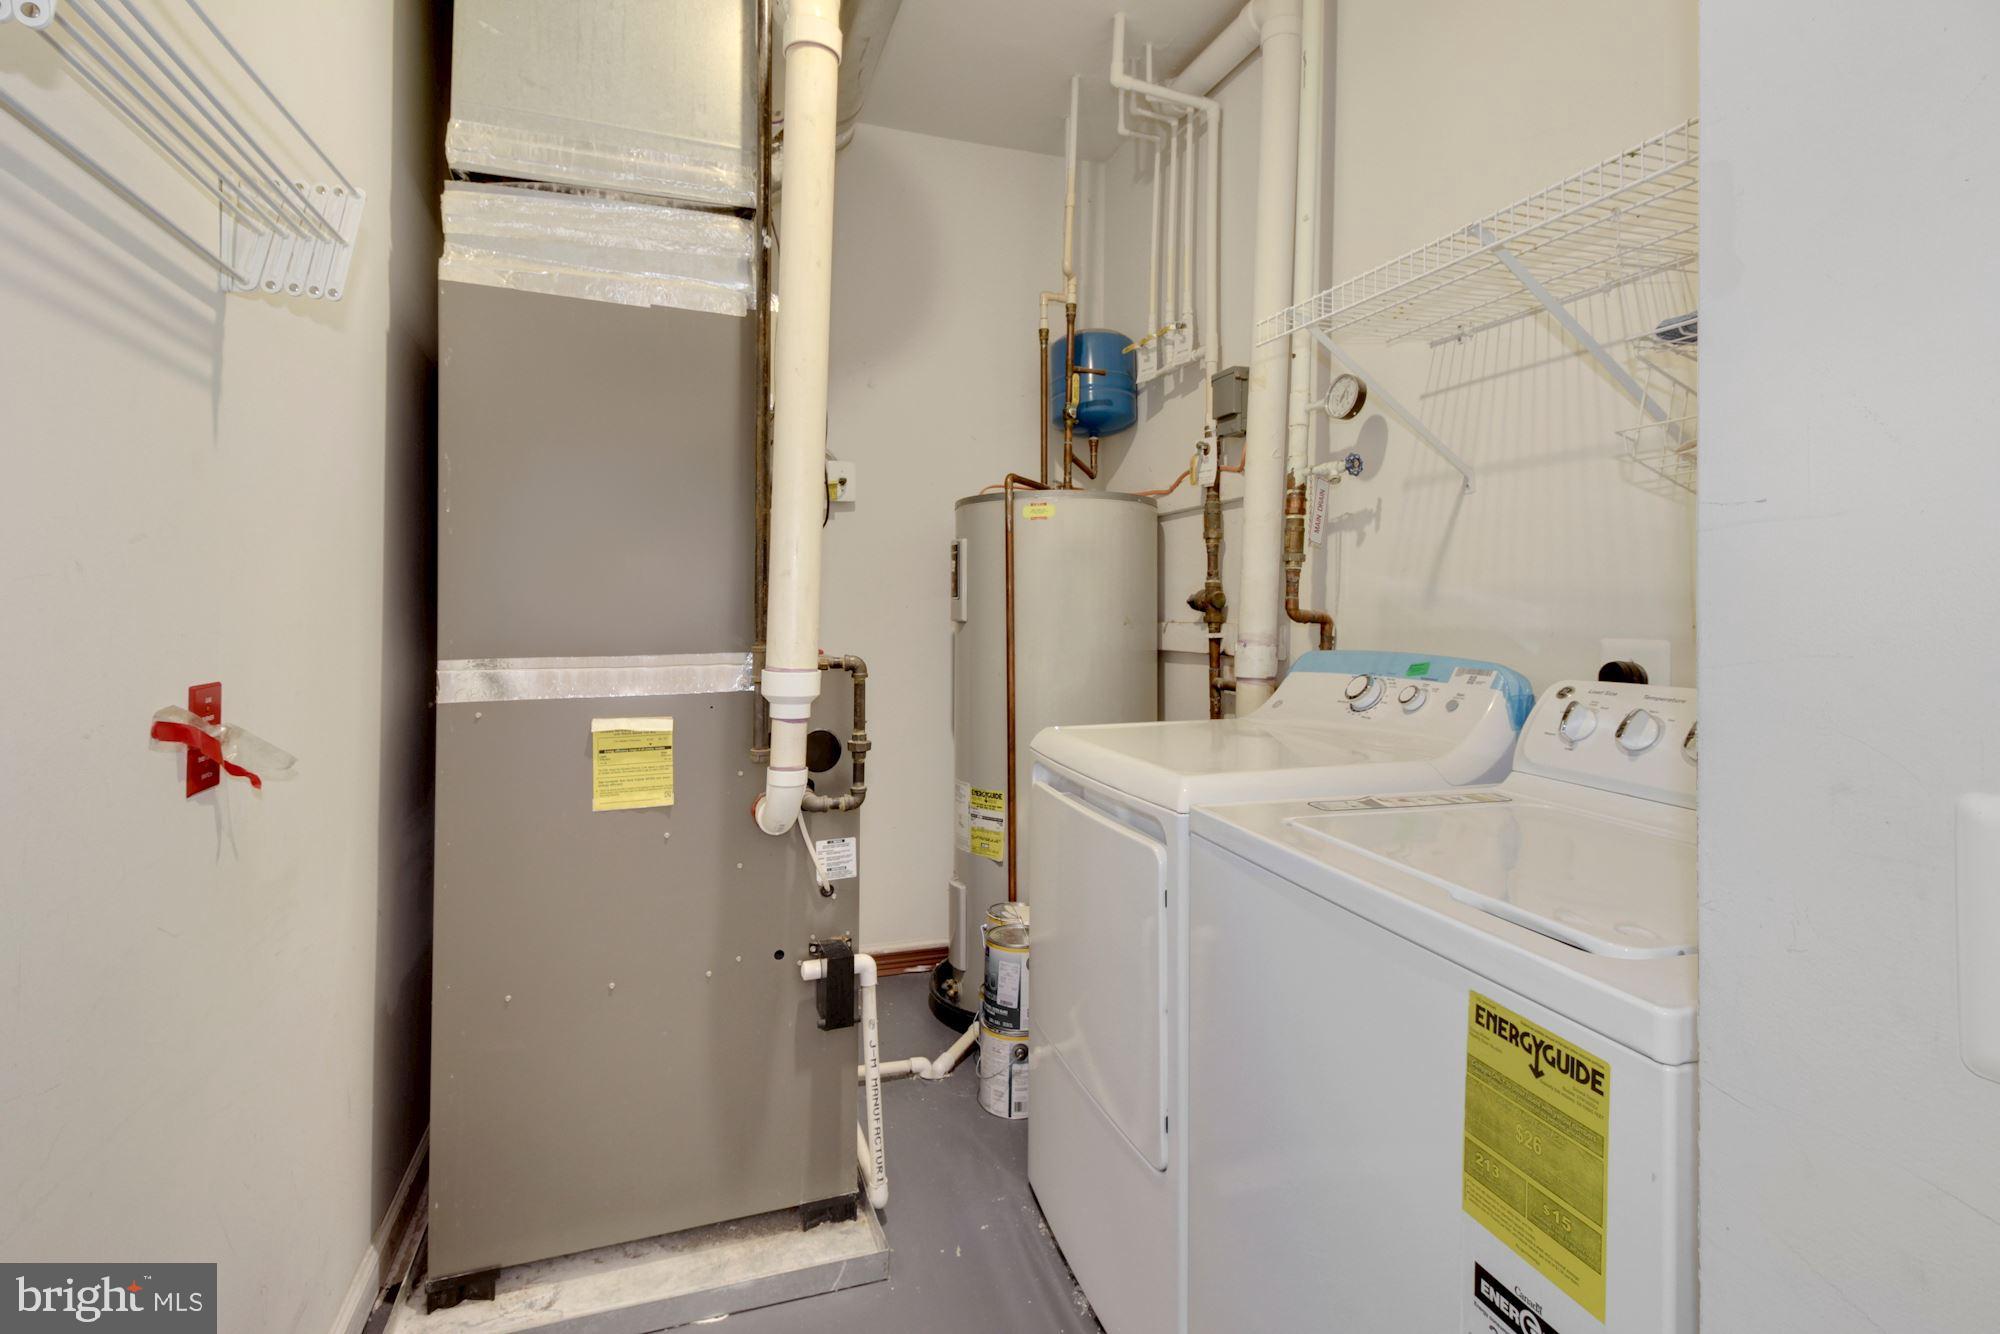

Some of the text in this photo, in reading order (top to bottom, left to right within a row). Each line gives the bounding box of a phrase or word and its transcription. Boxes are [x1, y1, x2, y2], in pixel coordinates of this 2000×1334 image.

[1317, 489, 1325, 512] DRAIN
[1475, 1004, 1605, 1096] ENERGYGUIDE
[1514, 1123, 1542, 1155] $26
[1475, 1152, 1499, 1178] 213
[1543, 1204, 1572, 1232] $15
